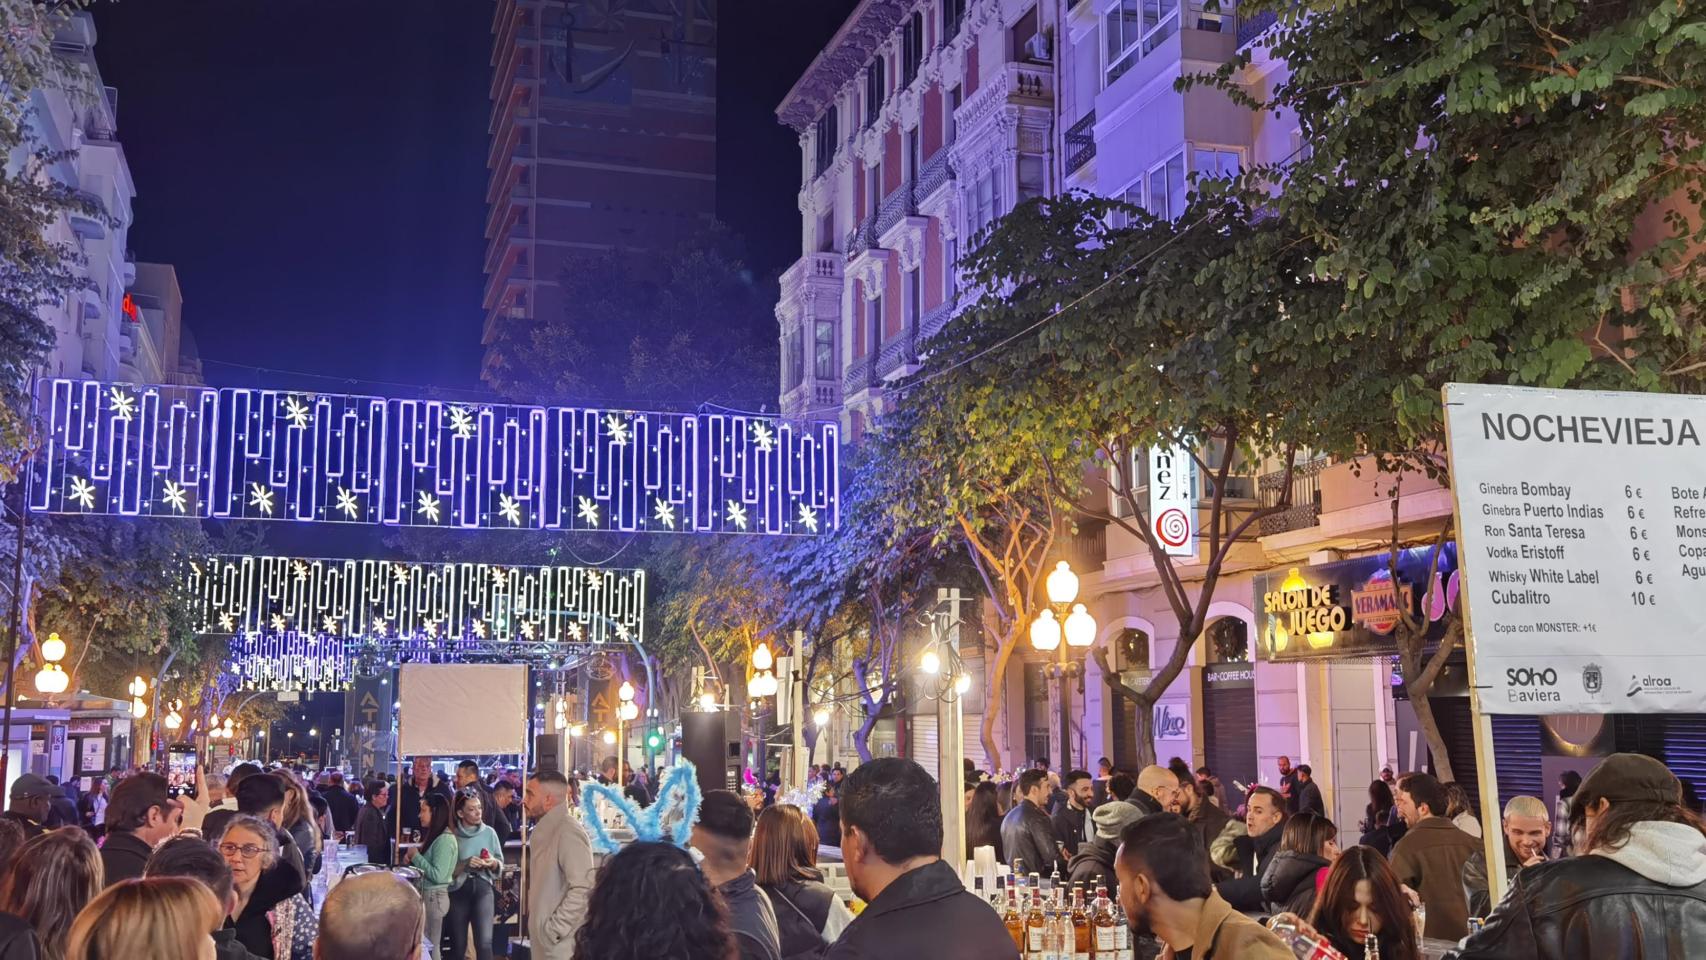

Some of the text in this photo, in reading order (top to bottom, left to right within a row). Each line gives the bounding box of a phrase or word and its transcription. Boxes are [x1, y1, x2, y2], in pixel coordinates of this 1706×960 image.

[1481, 413, 1700, 446] NOCHEVIEJA
[1479, 482, 1642, 500] Ginebra Bombay 6 €
[1671, 487, 1699, 499] Bote
[1482, 503, 1645, 519] Ginebra Puerto Indias 6 €
[1484, 523, 1648, 540] Ron Santa Teresa 6 €
[1486, 544, 1650, 561] Vodka Eristoff 6 €
[1489, 569, 1653, 585] Whisky White Label 6 €
[1264, 584, 1331, 613] SALON DE
[1492, 589, 1655, 605] Cubalitro 10 €
[1288, 606, 1346, 635] JUEGO
[1494, 623, 1597, 634] Copa con MONSTER: +1€
[1508, 688, 1560, 702] Baviera
